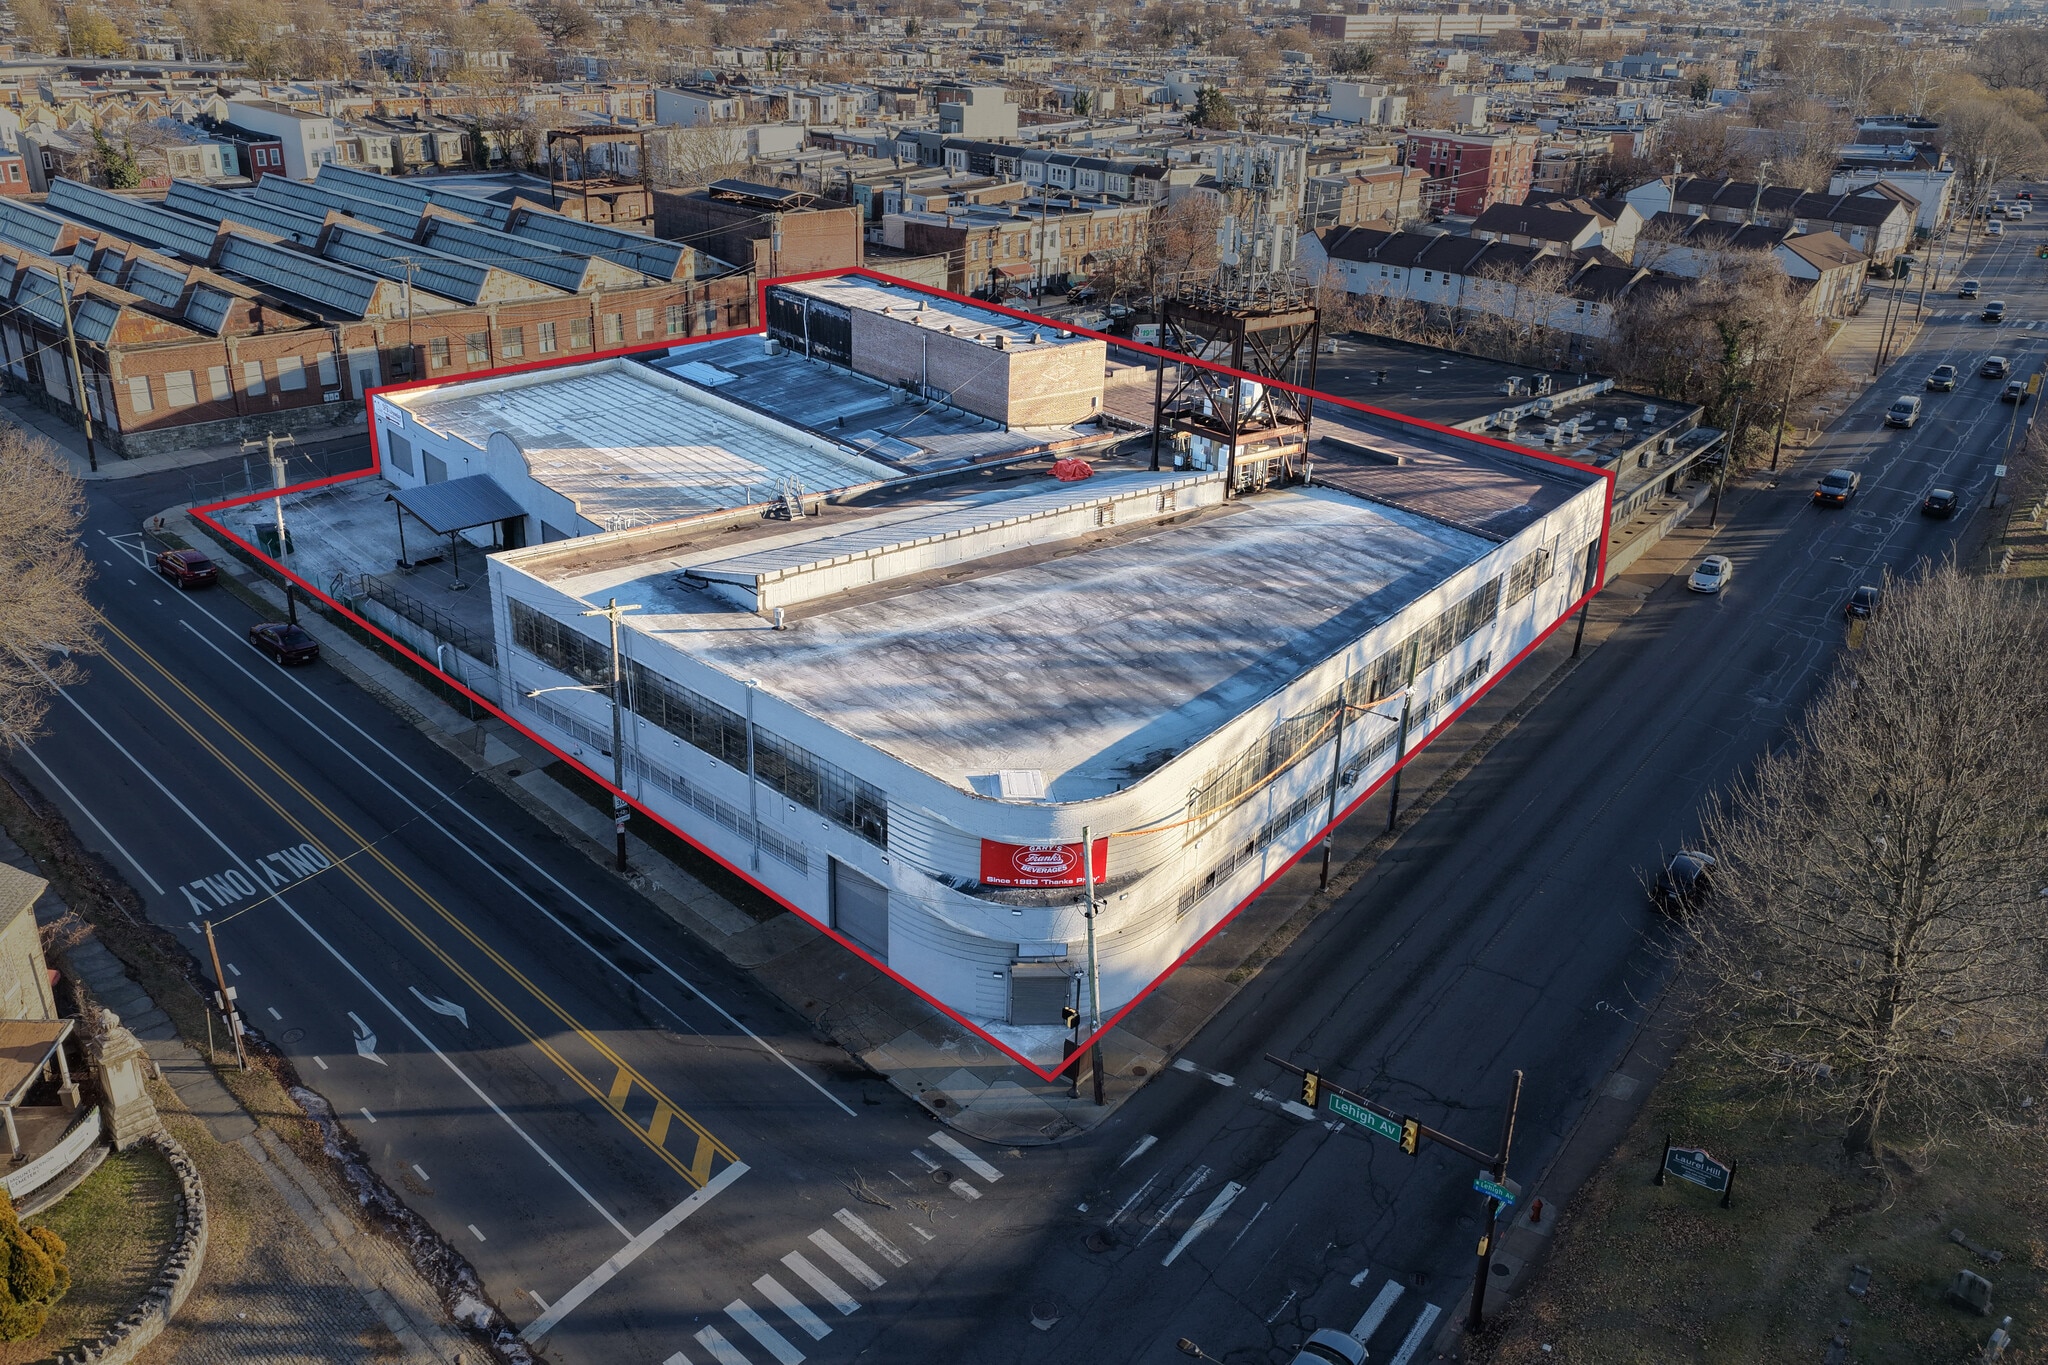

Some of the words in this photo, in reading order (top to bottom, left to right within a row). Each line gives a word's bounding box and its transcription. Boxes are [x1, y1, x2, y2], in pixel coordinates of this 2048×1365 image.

[256, 843, 331, 887] ONLY
[1021, 864, 1067, 874] BEVERAGES
[1025, 853, 1063, 865] Frank's
[987, 876, 1011, 884] Since
[179, 869, 257, 916] ONLY
[1335, 1099, 1375, 1125] Lehigh
[1379, 1121, 1396, 1135] Av
[1675, 1153, 1704, 1170] Laurel
[1705, 1166, 1721, 1177] Hill
[1480, 1181, 1503, 1195] Lehigh
[1505, 1192, 1514, 1200] Av
